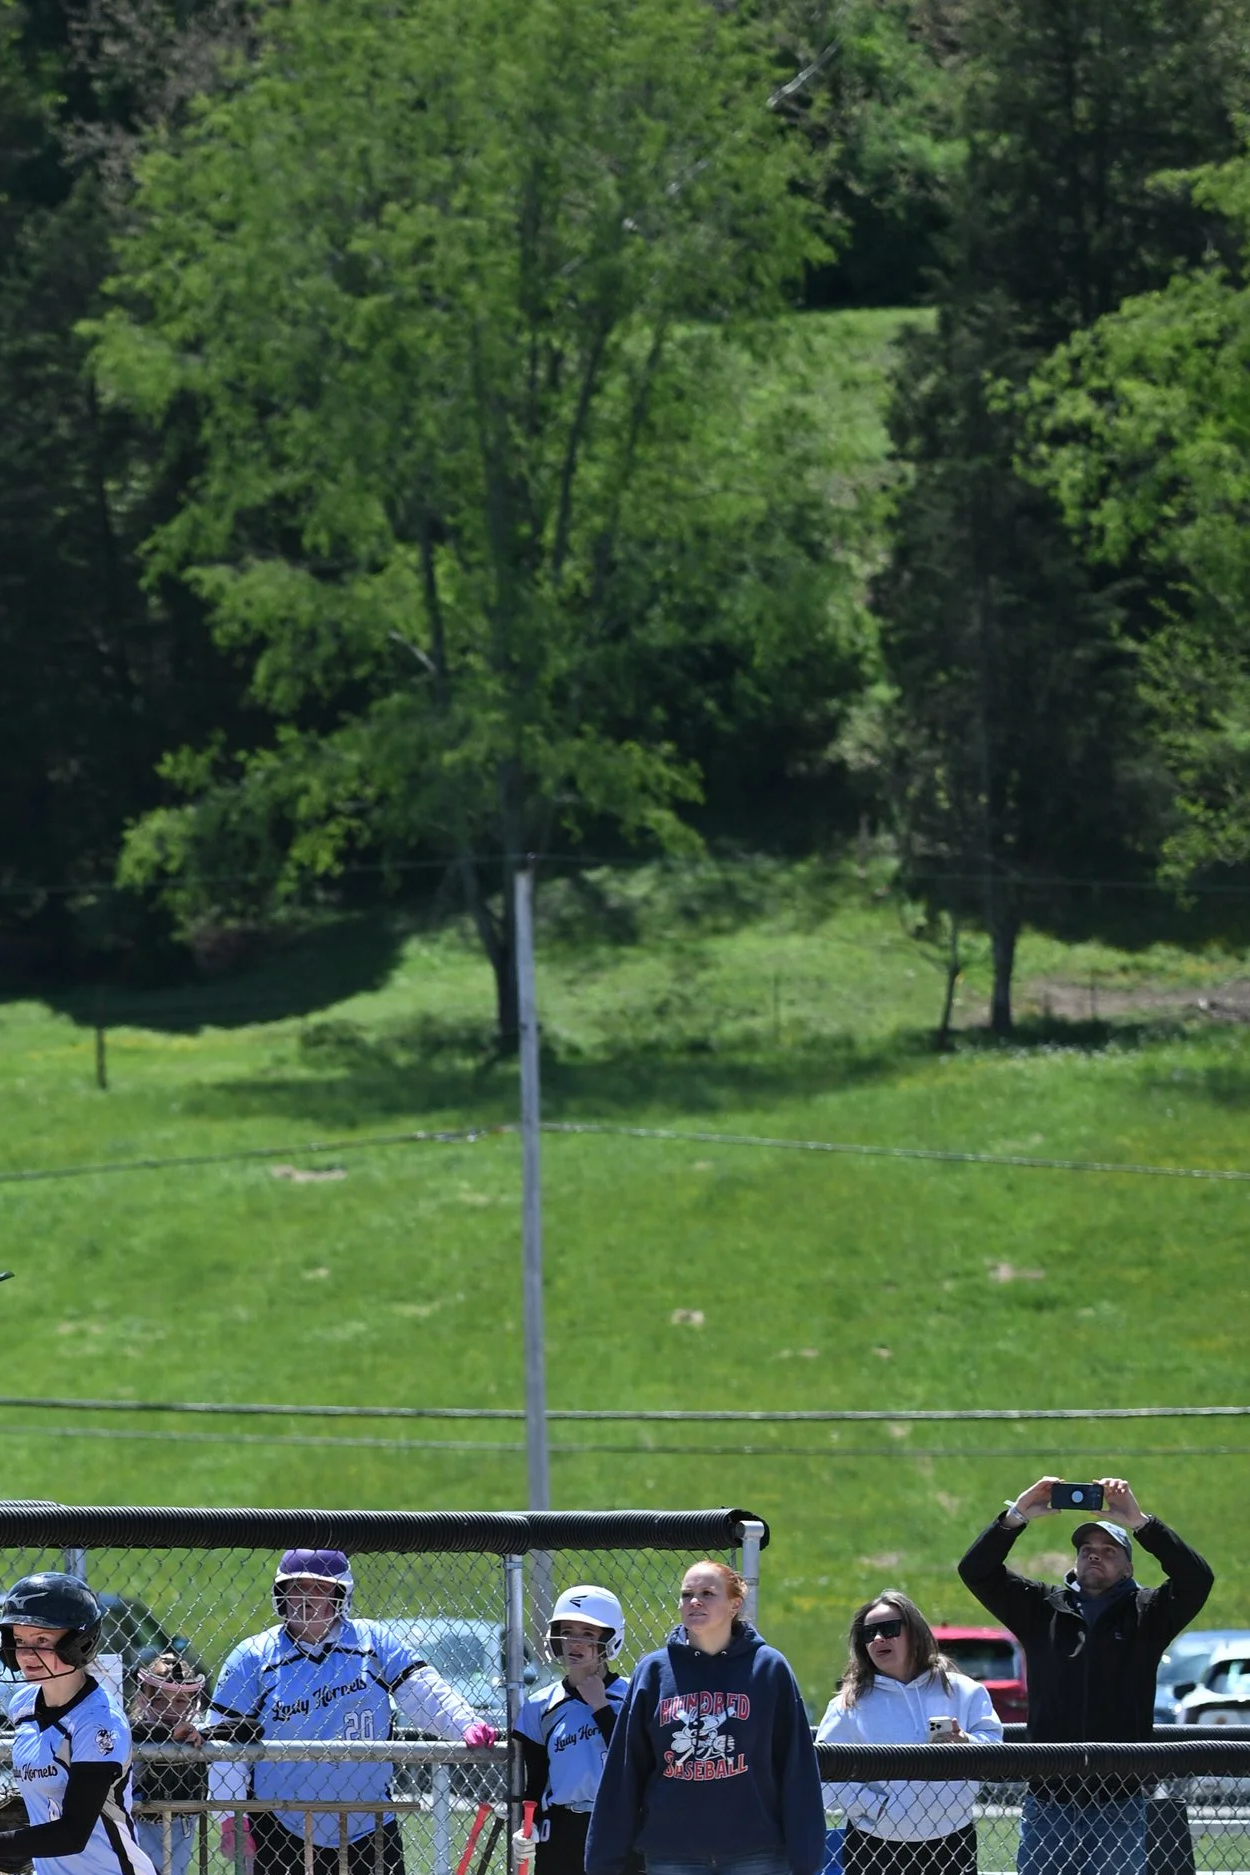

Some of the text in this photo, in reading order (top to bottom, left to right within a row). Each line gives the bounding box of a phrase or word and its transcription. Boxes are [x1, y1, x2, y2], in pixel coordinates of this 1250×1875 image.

[272, 1679, 367, 1721] Lady Hornets
[659, 1691, 750, 1727] HUNDRED
[343, 1708, 374, 1740] 20
[554, 1733, 577, 1753] Lady
[22, 1763, 58, 1782] Hornets
[663, 1751, 748, 1781] BASEBALL
